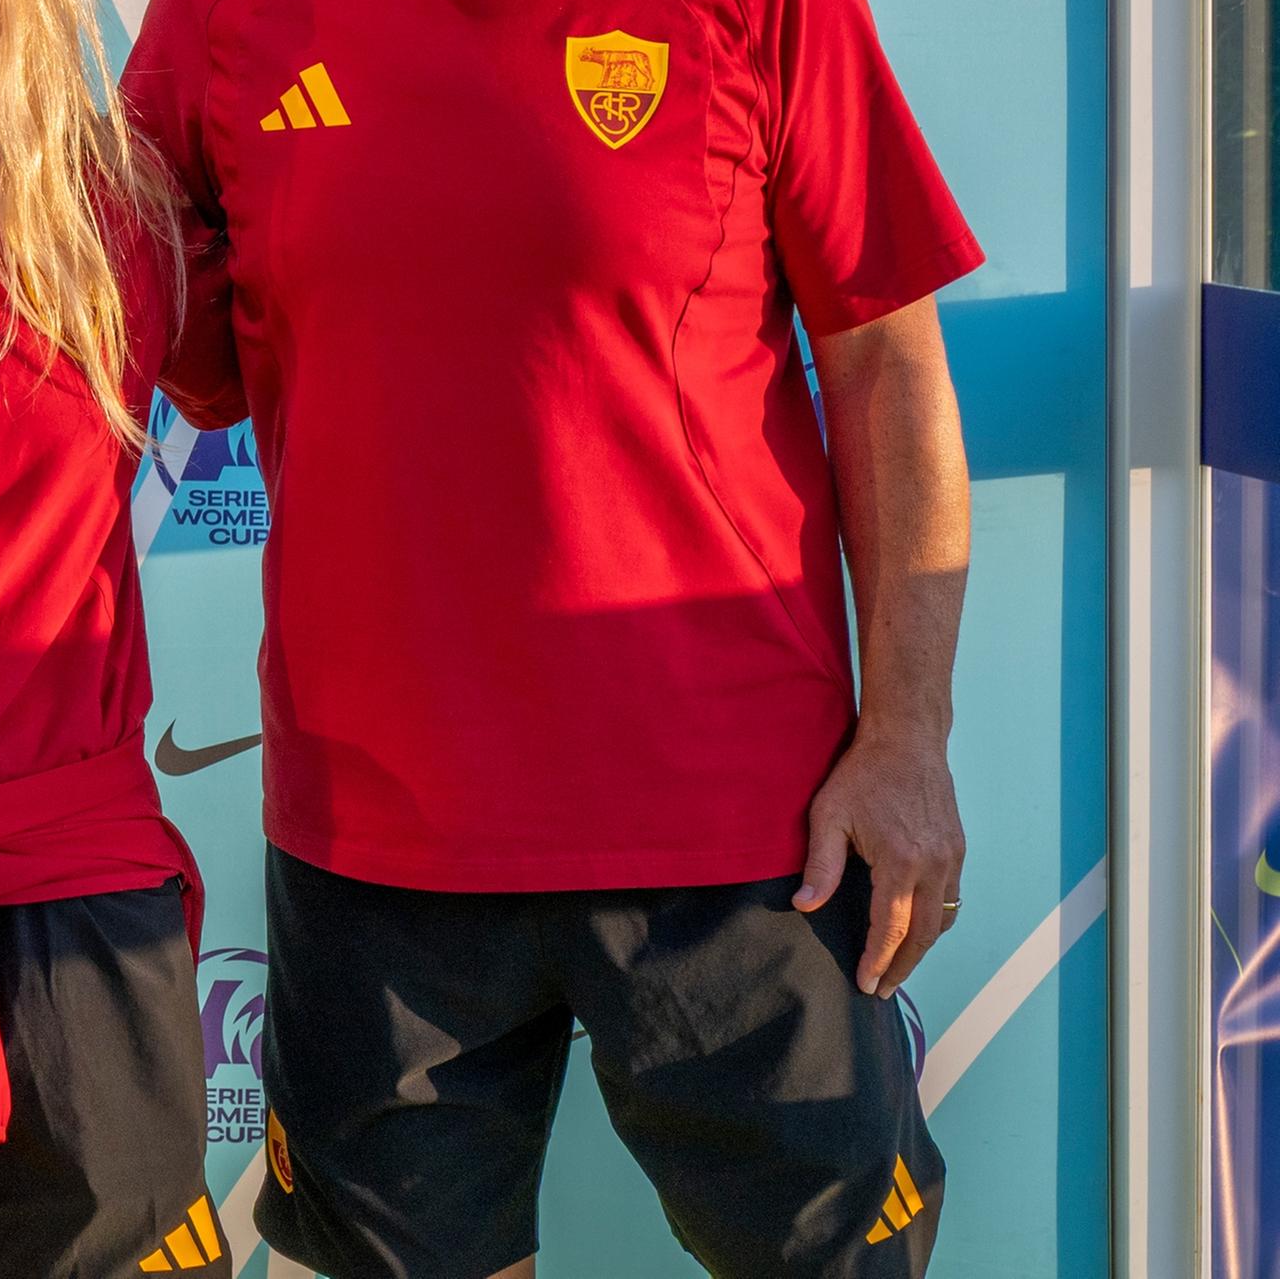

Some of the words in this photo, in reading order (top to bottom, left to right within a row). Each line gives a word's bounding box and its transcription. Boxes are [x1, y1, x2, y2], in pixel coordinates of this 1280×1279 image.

[188, 489, 266, 507] SERIE
[172, 508, 270, 526] WOME
[208, 528, 269, 545] CUP
[206, 1088, 261, 1105] ERIE
[206, 1126, 265, 1143] CUP
